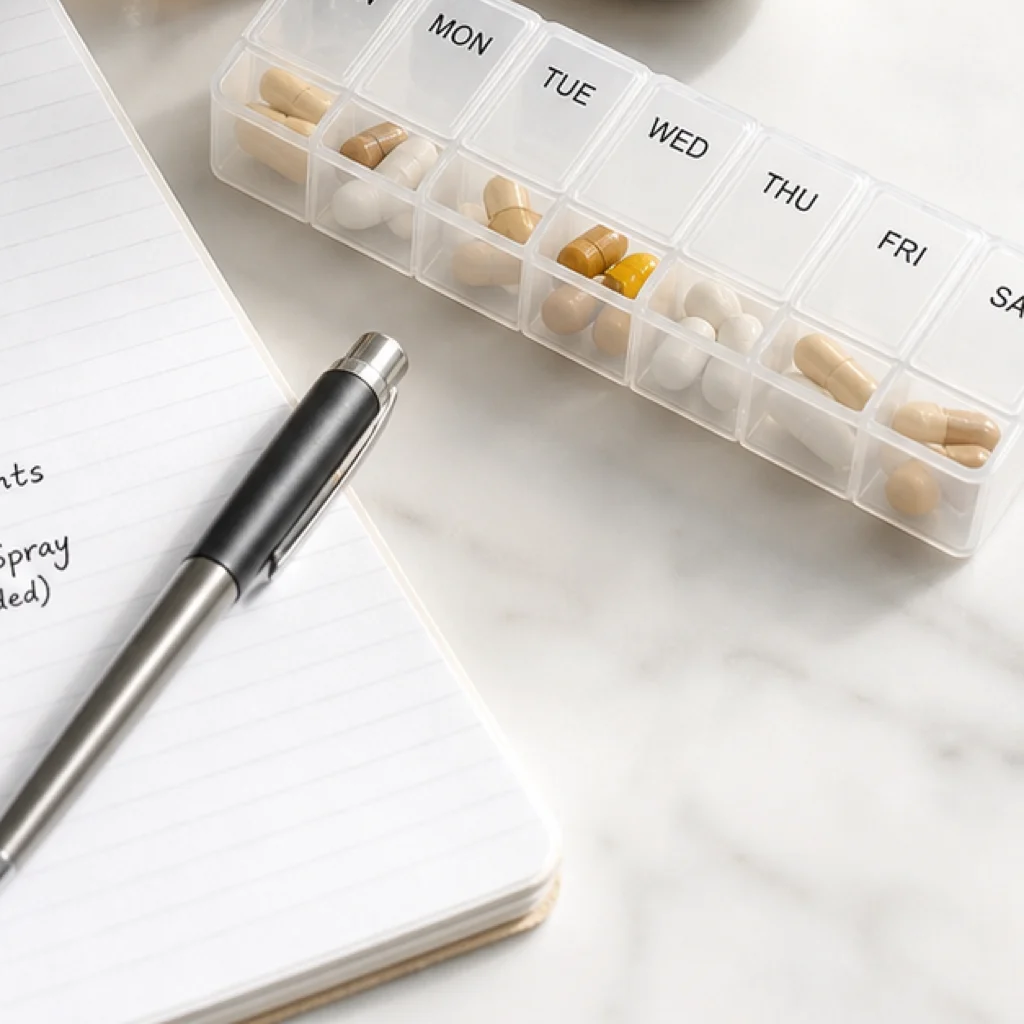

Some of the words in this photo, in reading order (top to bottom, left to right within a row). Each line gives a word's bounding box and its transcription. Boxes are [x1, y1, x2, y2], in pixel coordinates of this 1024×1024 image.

[428, 13, 494, 56] MON
[543, 66, 597, 106] TUE
[649, 116, 709, 159] WED
[763, 172, 819, 212] THU
[877, 230, 927, 267] FRI
